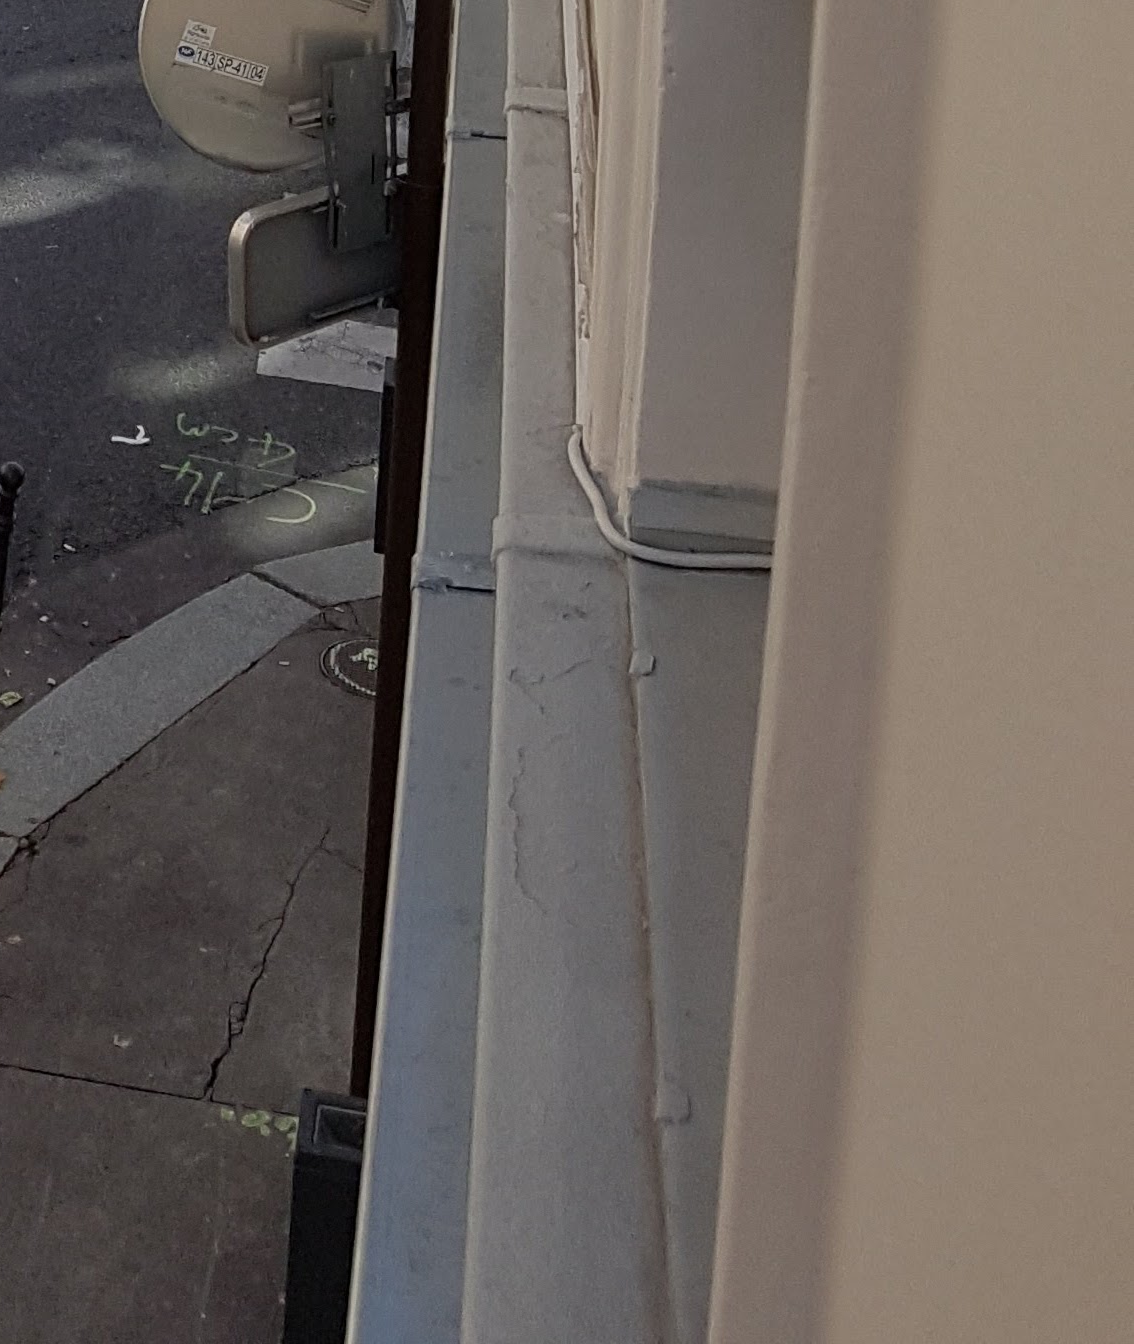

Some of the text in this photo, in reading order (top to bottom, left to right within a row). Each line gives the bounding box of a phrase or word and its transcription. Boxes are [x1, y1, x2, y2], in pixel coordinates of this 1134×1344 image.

[197, 50, 215, 66] 143
[217, 56, 247, 77] SP-41
[250, 66, 264, 80] 04
